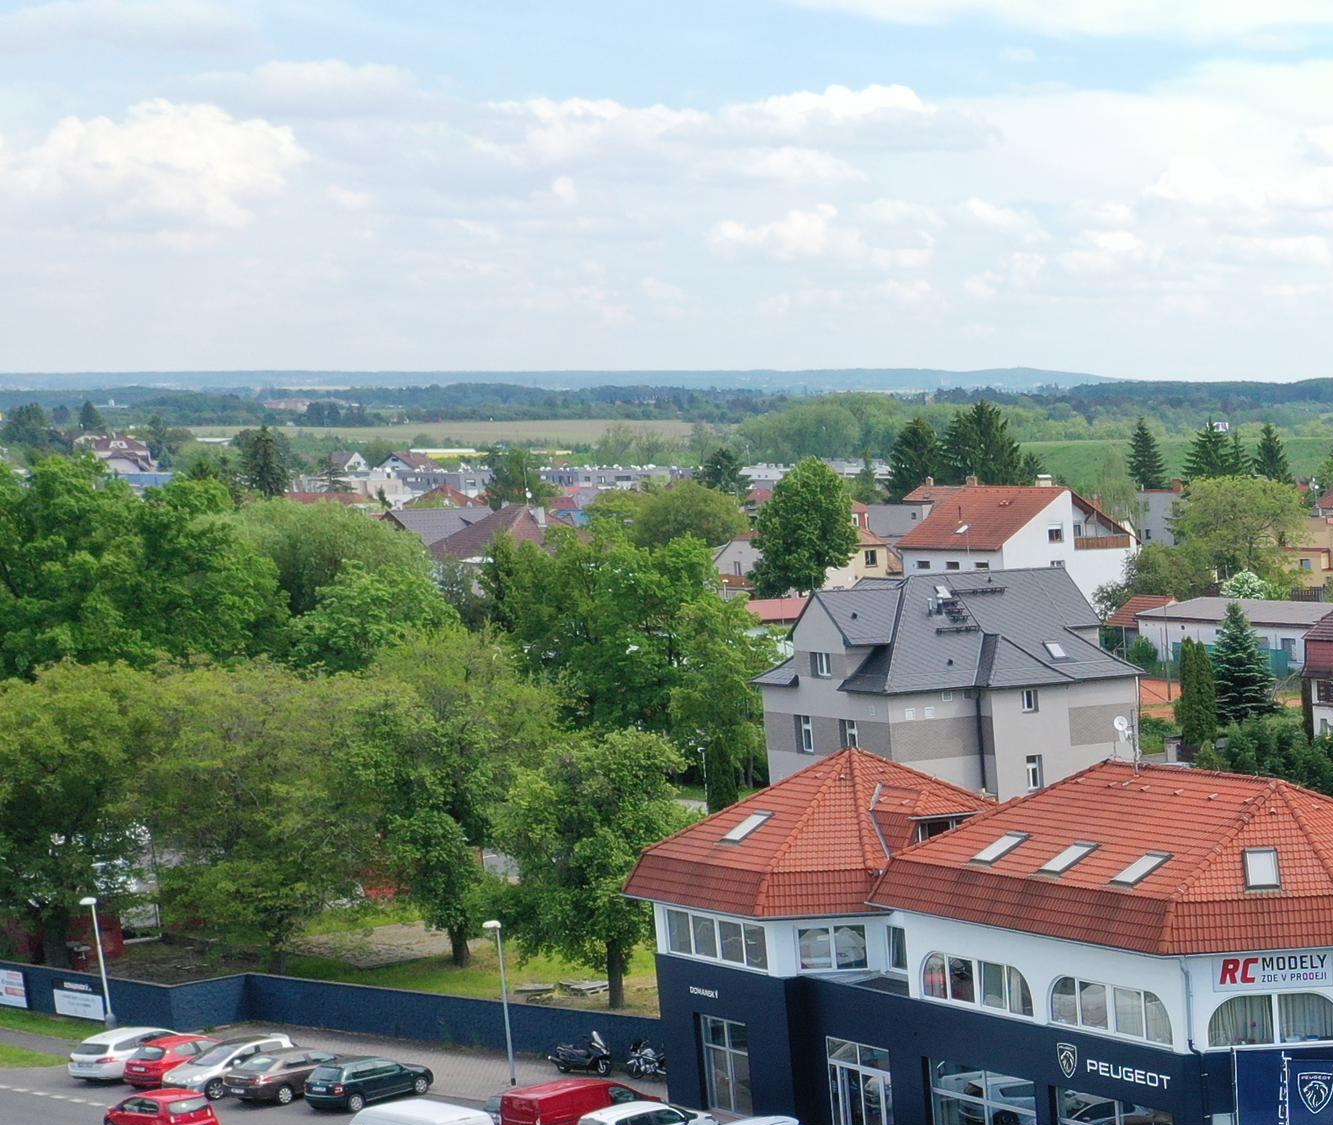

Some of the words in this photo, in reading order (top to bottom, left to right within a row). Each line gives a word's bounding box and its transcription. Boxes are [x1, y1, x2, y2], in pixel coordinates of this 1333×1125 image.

[1219, 957, 1260, 985] RC
[1261, 953, 1327, 971] MODELY
[1261, 972, 1279, 983] ZDE
[1281, 972, 1288, 982] V
[1086, 1059, 1171, 1090] PEUGEOT
